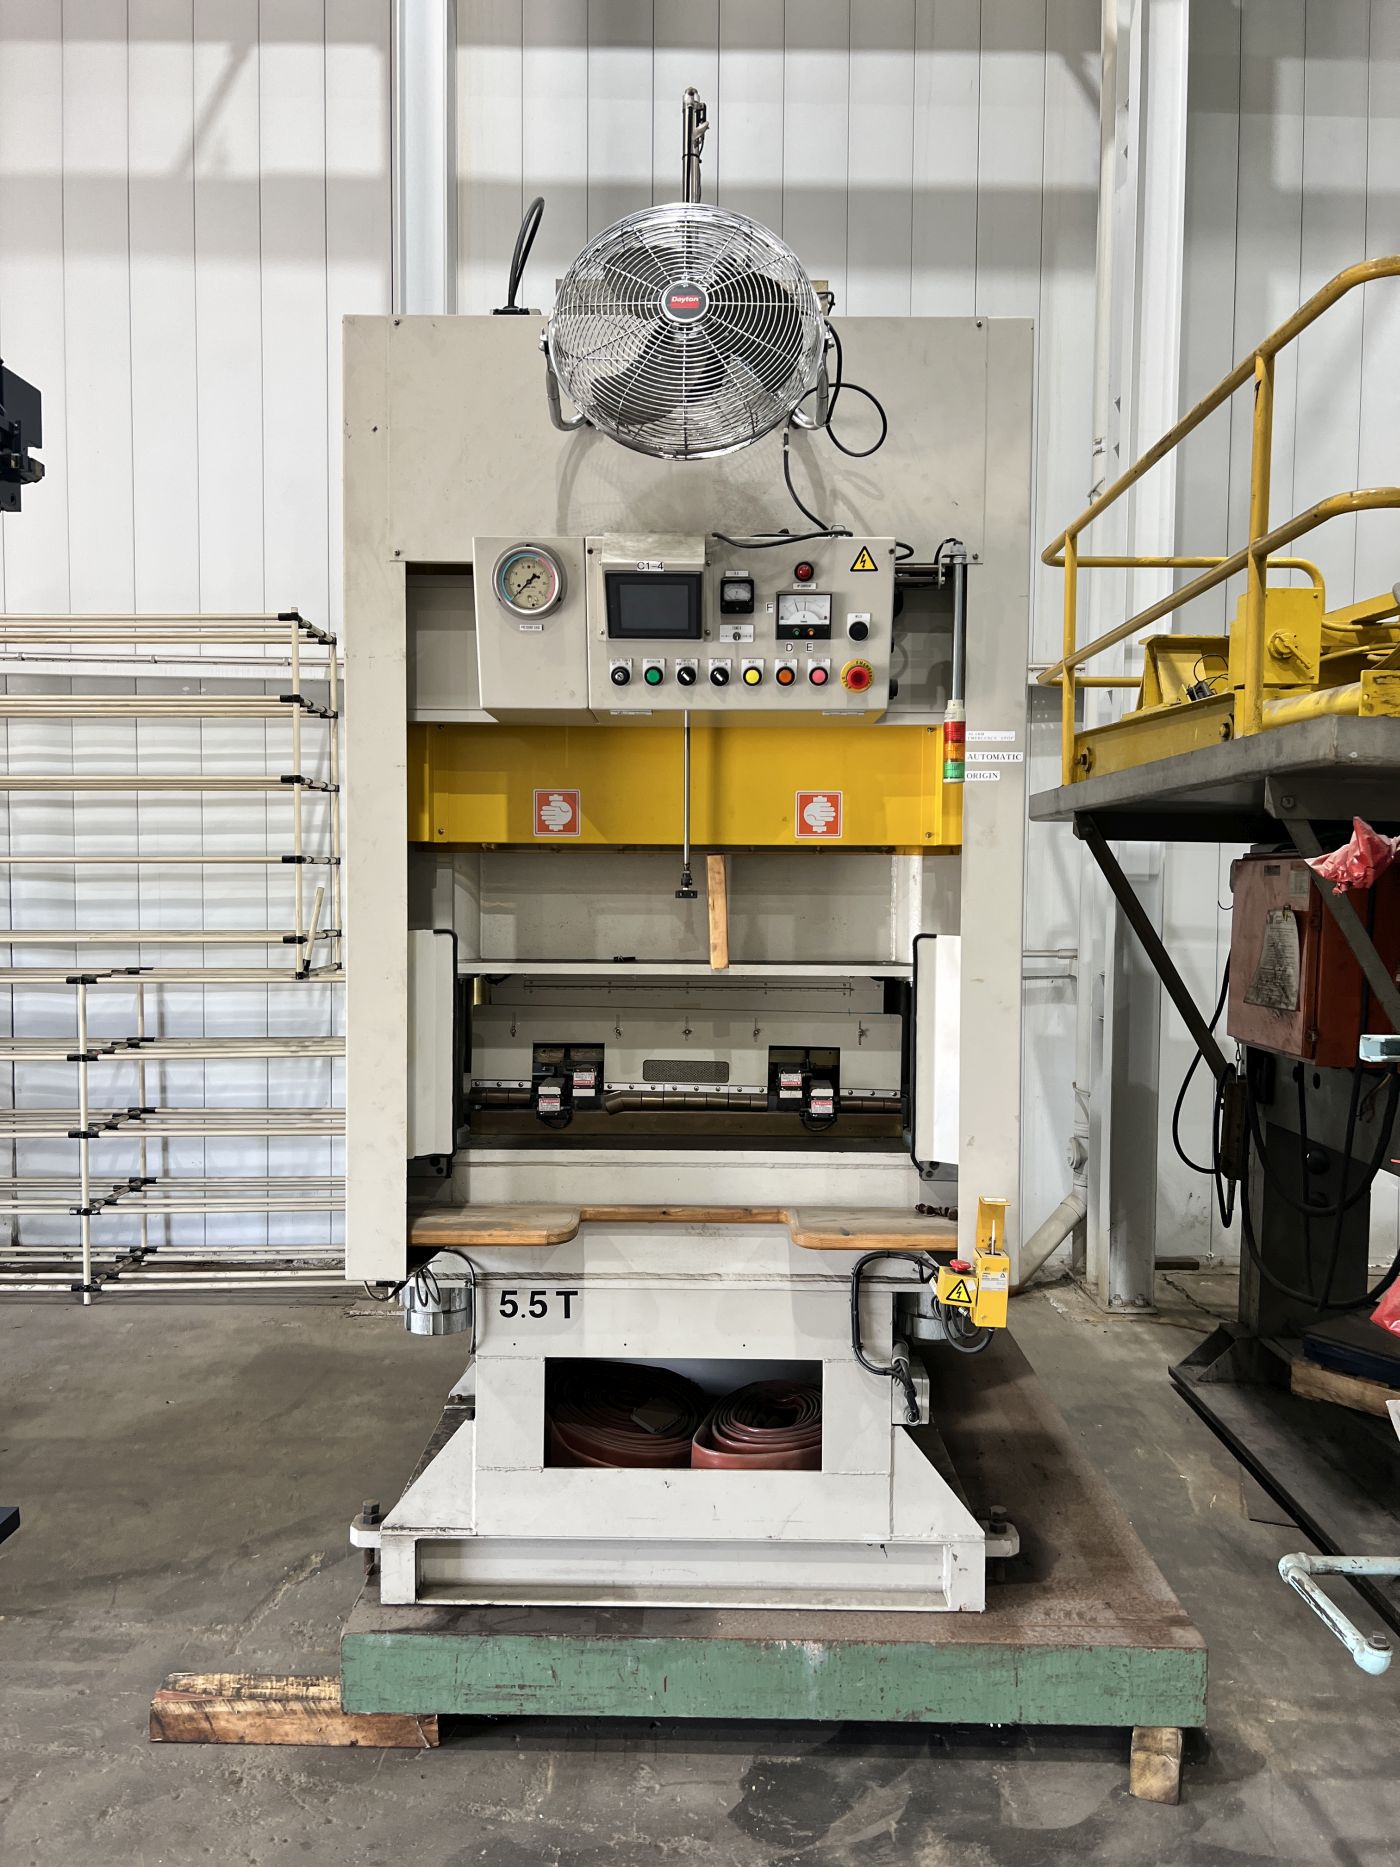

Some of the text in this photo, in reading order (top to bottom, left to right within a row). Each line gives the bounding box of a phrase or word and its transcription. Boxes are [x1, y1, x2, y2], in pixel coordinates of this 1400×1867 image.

[636, 561, 664, 570] C1-4
[766, 603, 773, 612] F
[785, 643, 813, 652] D E
[499, 1290, 578, 1319] 5.5 T
